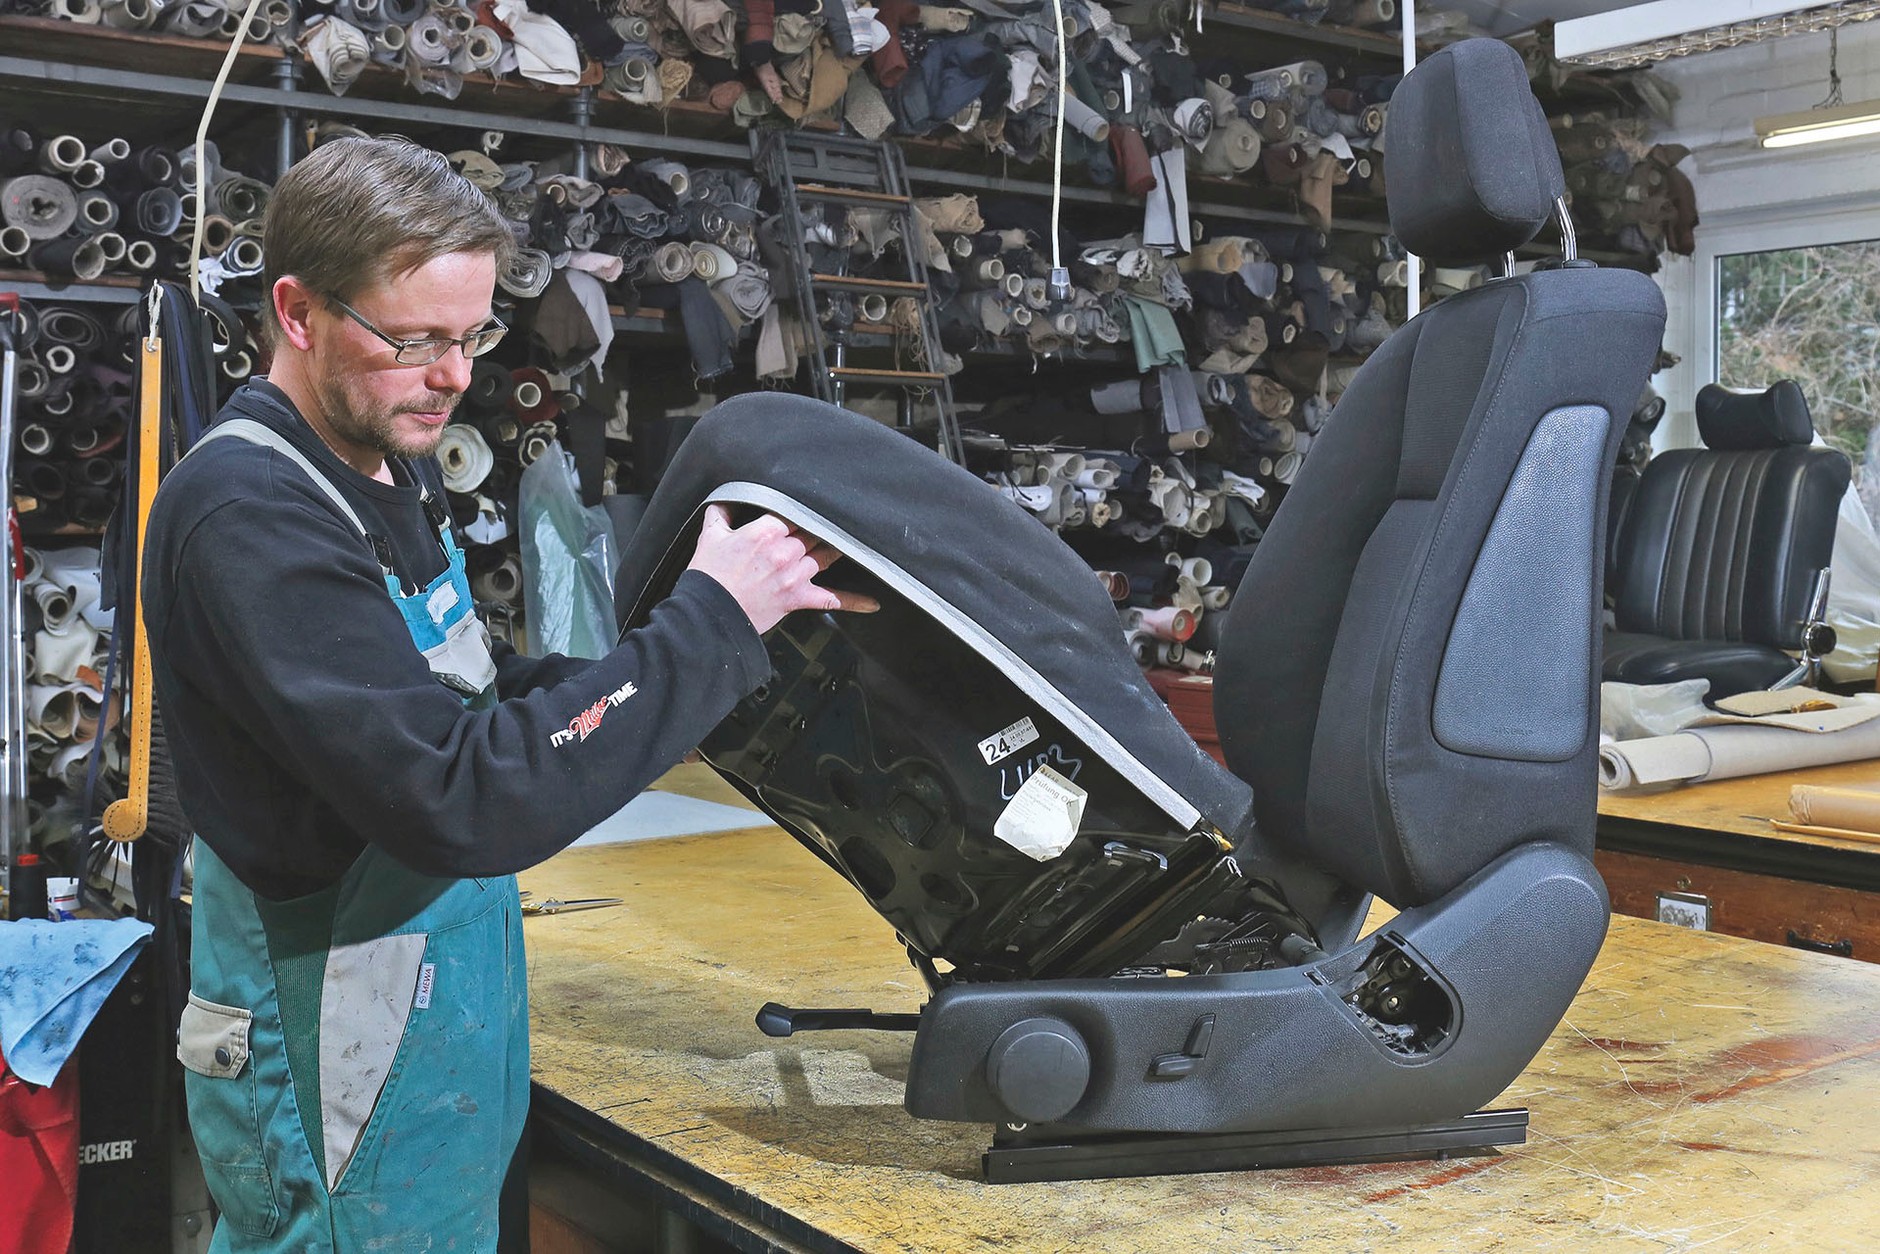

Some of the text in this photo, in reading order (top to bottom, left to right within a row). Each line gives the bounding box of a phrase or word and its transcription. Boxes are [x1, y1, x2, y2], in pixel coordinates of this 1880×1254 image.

[549, 681, 638, 748] IT'S Miller TIME
[985, 737, 1011, 761] 24
[1060, 795, 1073, 808] OK
[421, 968, 432, 994] MEWA
